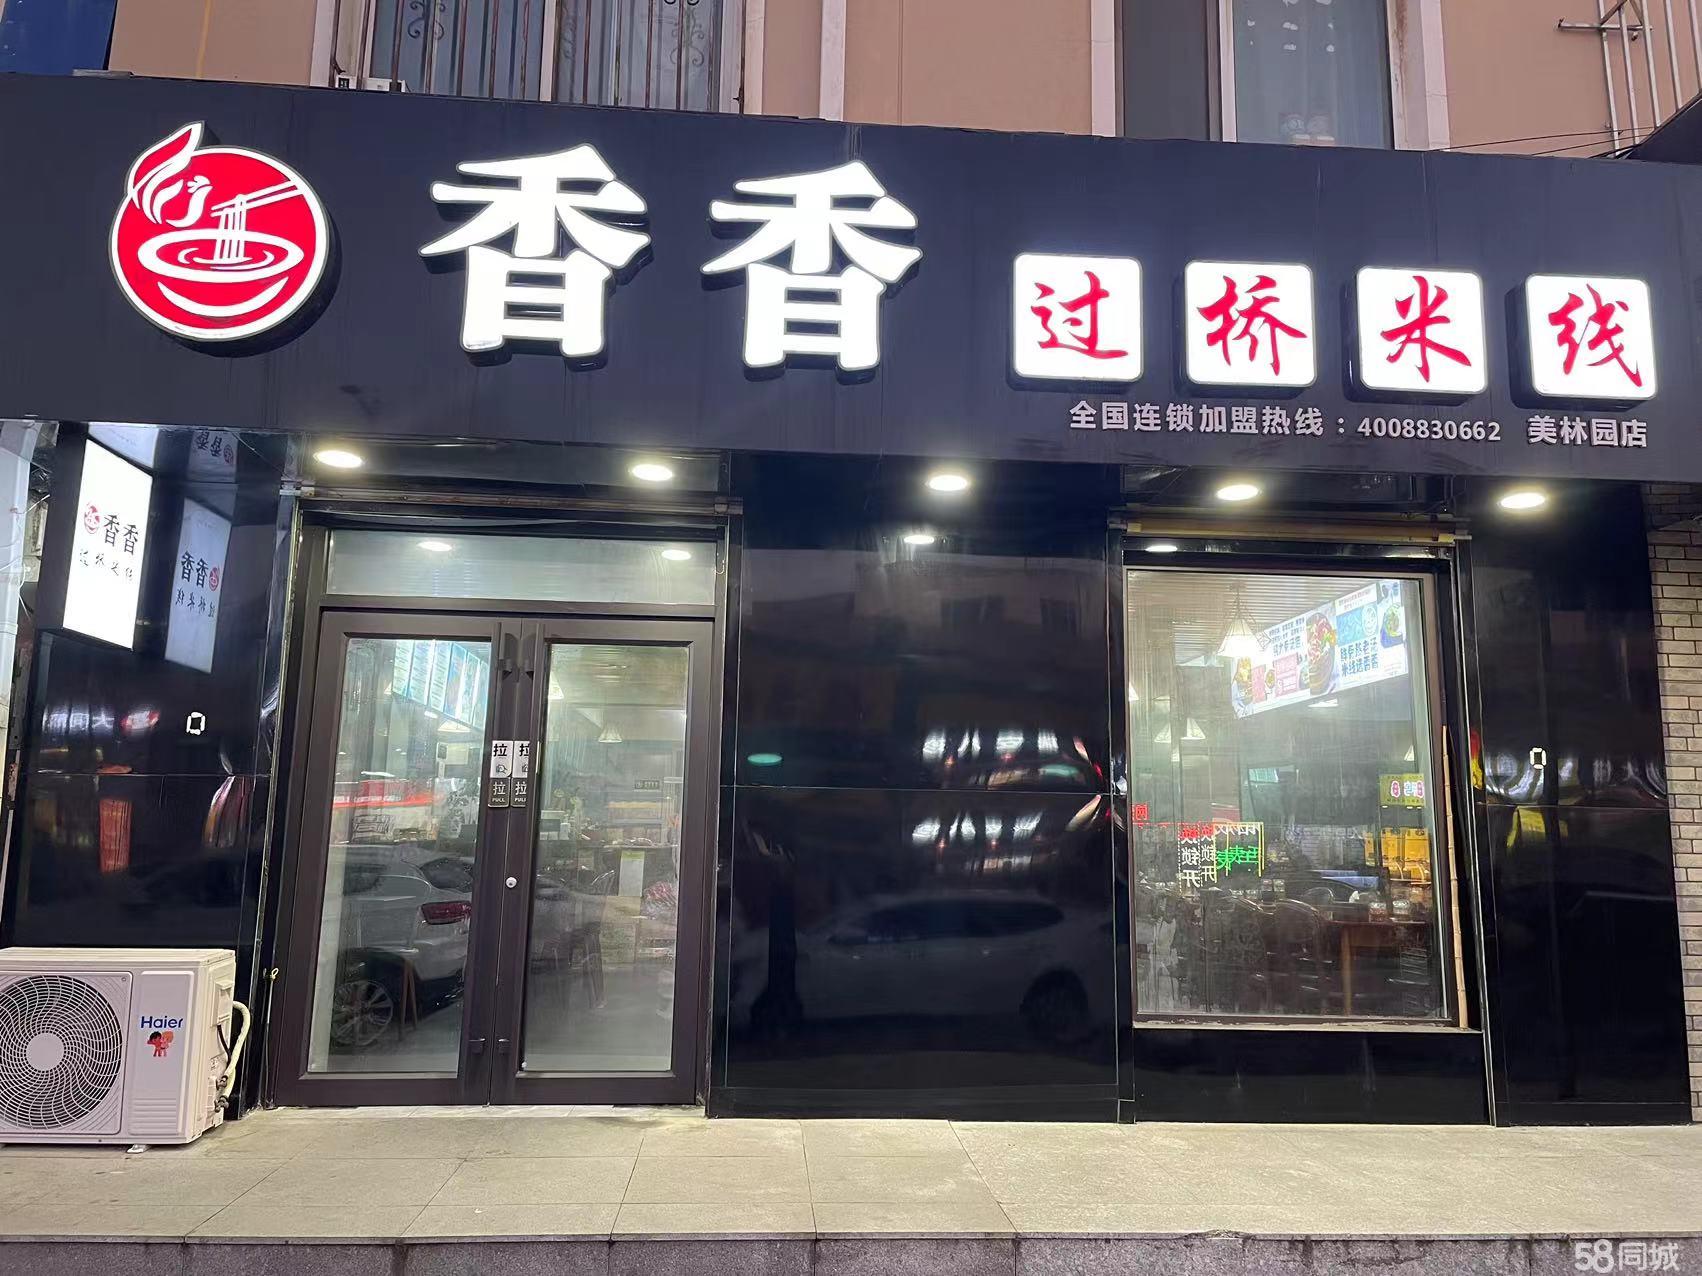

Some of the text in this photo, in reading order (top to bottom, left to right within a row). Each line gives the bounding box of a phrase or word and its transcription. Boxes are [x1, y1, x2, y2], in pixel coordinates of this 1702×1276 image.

[421, 145, 921, 369] 香香
[1032, 271, 1643, 386] 过桥米线
[1528, 415, 1647, 447] 美林园店
[104, 513, 139, 555] 香香
[493, 744, 508, 757] 拉
[493, 781, 506, 795] 拉
[515, 781, 527, 795] 拉
[140, 1015, 184, 1029] Haier
